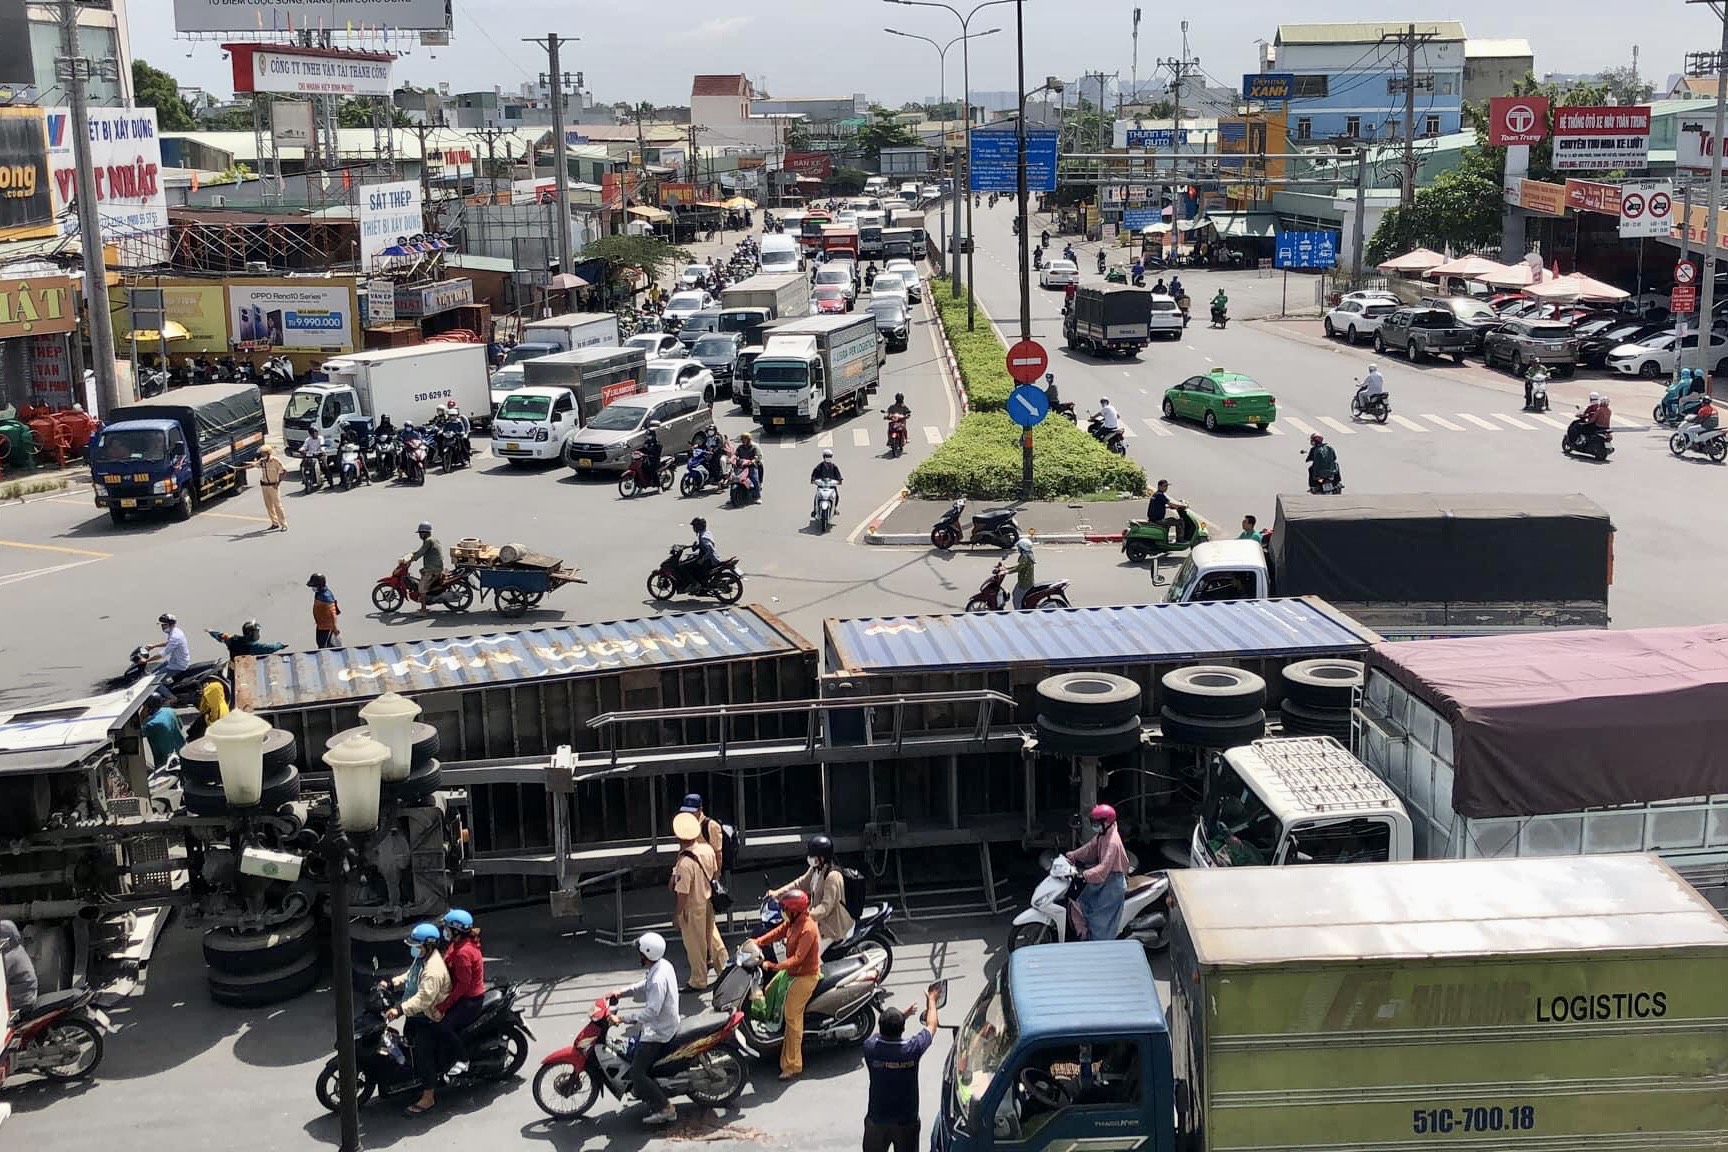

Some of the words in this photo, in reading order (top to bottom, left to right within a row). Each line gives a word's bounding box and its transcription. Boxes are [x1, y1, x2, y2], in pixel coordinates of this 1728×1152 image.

[271, 57, 289, 74] CÔNG
[291, 61, 300, 75] TY
[303, 62, 320, 76] TNHH
[371, 64, 387, 79] CÔNG
[1251, 86, 1288, 96] XANH
[102, 121, 112, 143] BỊ
[114, 116, 129, 140] XÂY
[132, 119, 153, 142] DỰNG
[1145, 138, 1170, 146] AUTO
[1560, 138, 1586, 149] CHUYÊN
[1587, 139, 1600, 149] THU
[1600, 139, 1615, 149] MUA
[1616, 139, 1626, 149] XE
[54, 165, 104, 203] VIT
[108, 155, 158, 204] NHẬT
[370, 187, 387, 210] SẮT
[388, 187, 412, 208] THÉP
[251, 292, 272, 300] OPPO
[300, 292, 321, 300] Series
[296, 318, 340, 327] 9.990.000
[414, 393, 428, 402] 51D
[1536, 992, 1668, 1022] LOGISTICS
[1413, 1105, 1535, 1134] 51C-700.18
